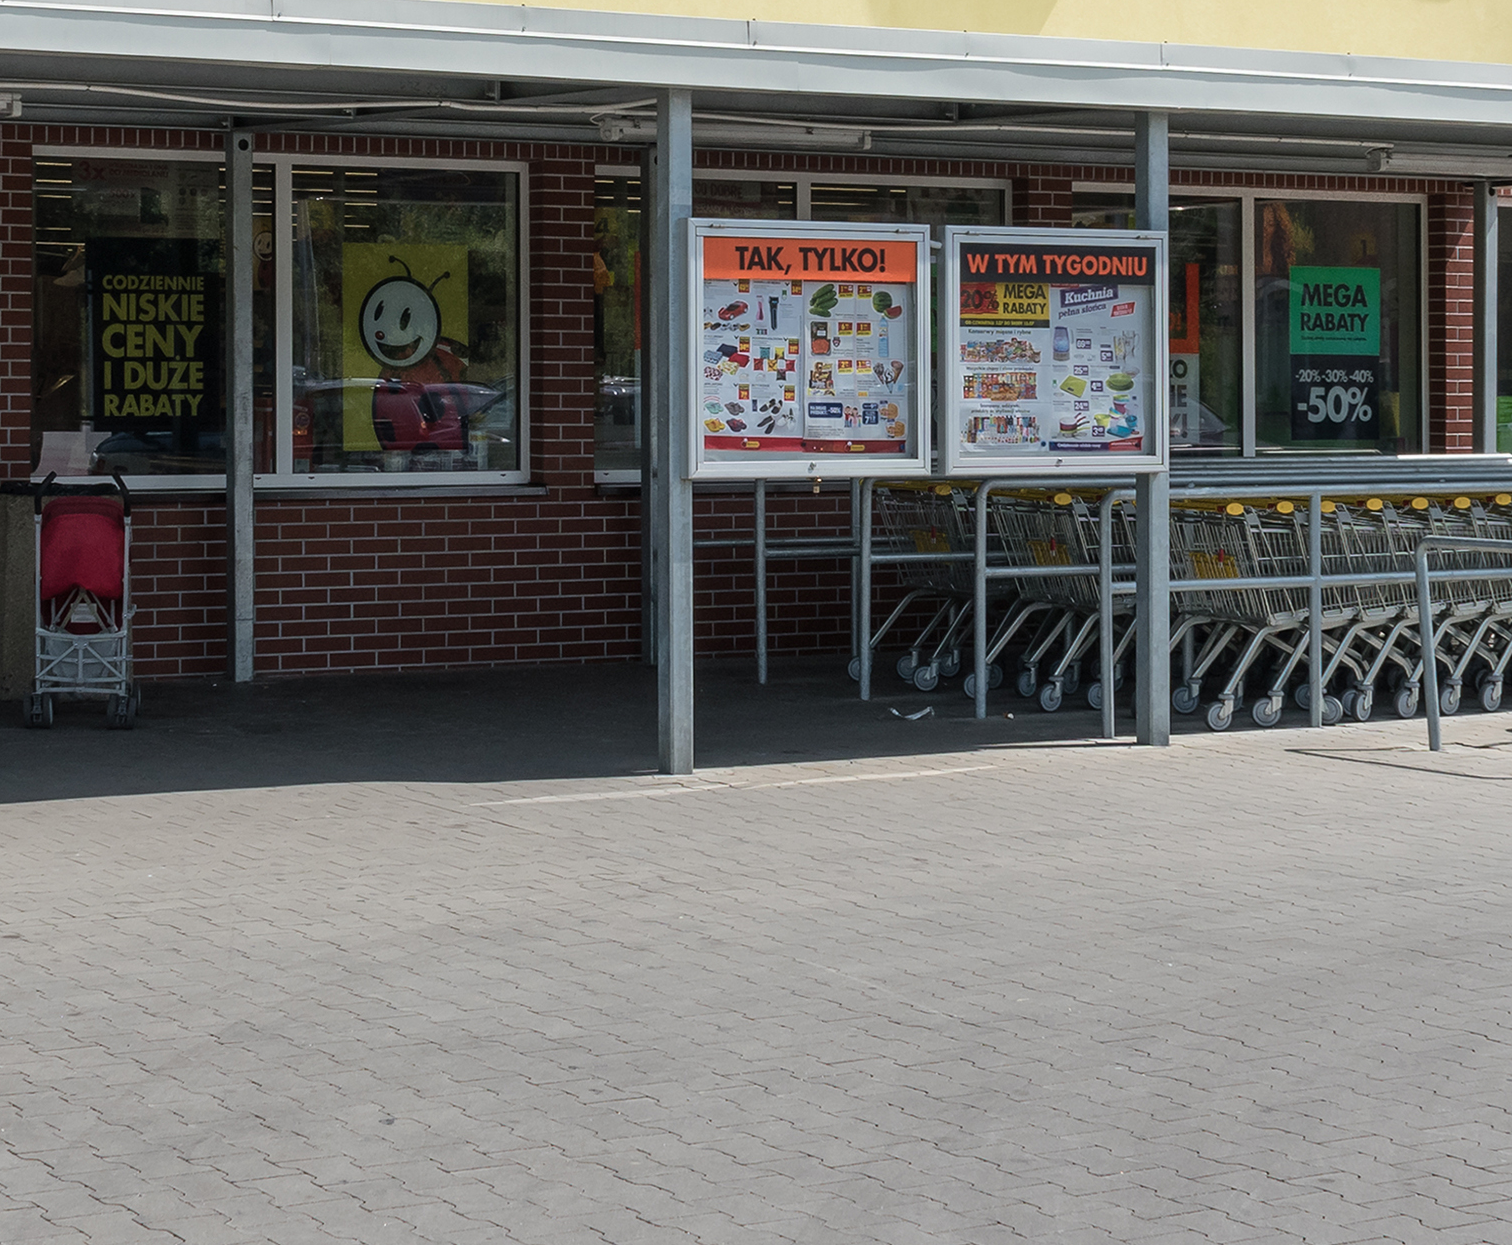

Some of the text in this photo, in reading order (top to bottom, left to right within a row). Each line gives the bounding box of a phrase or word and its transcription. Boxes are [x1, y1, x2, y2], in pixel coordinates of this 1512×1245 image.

[735, 245, 886, 275] TAK, TYLKO!
[967, 253, 1148, 276] W TYM TYGODNIU
[101, 274, 205, 291] CODZIENNIE
[1003, 284, 1047, 300] MEGA
[102, 292, 205, 322] NISKIE
[1064, 287, 1114, 305] Kuchnia
[1300, 283, 1368, 308] MEGA
[1003, 302, 1047, 315] RABATY
[1300, 312, 1369, 332] RABATY
[101, 323, 204, 358] CENY
[103, 355, 204, 390] I DUŻE
[1295, 368, 1374, 384] -20% -30% -40%
[104, 394, 204, 417] RABATY
[1297, 385, 1373, 423] -50%
